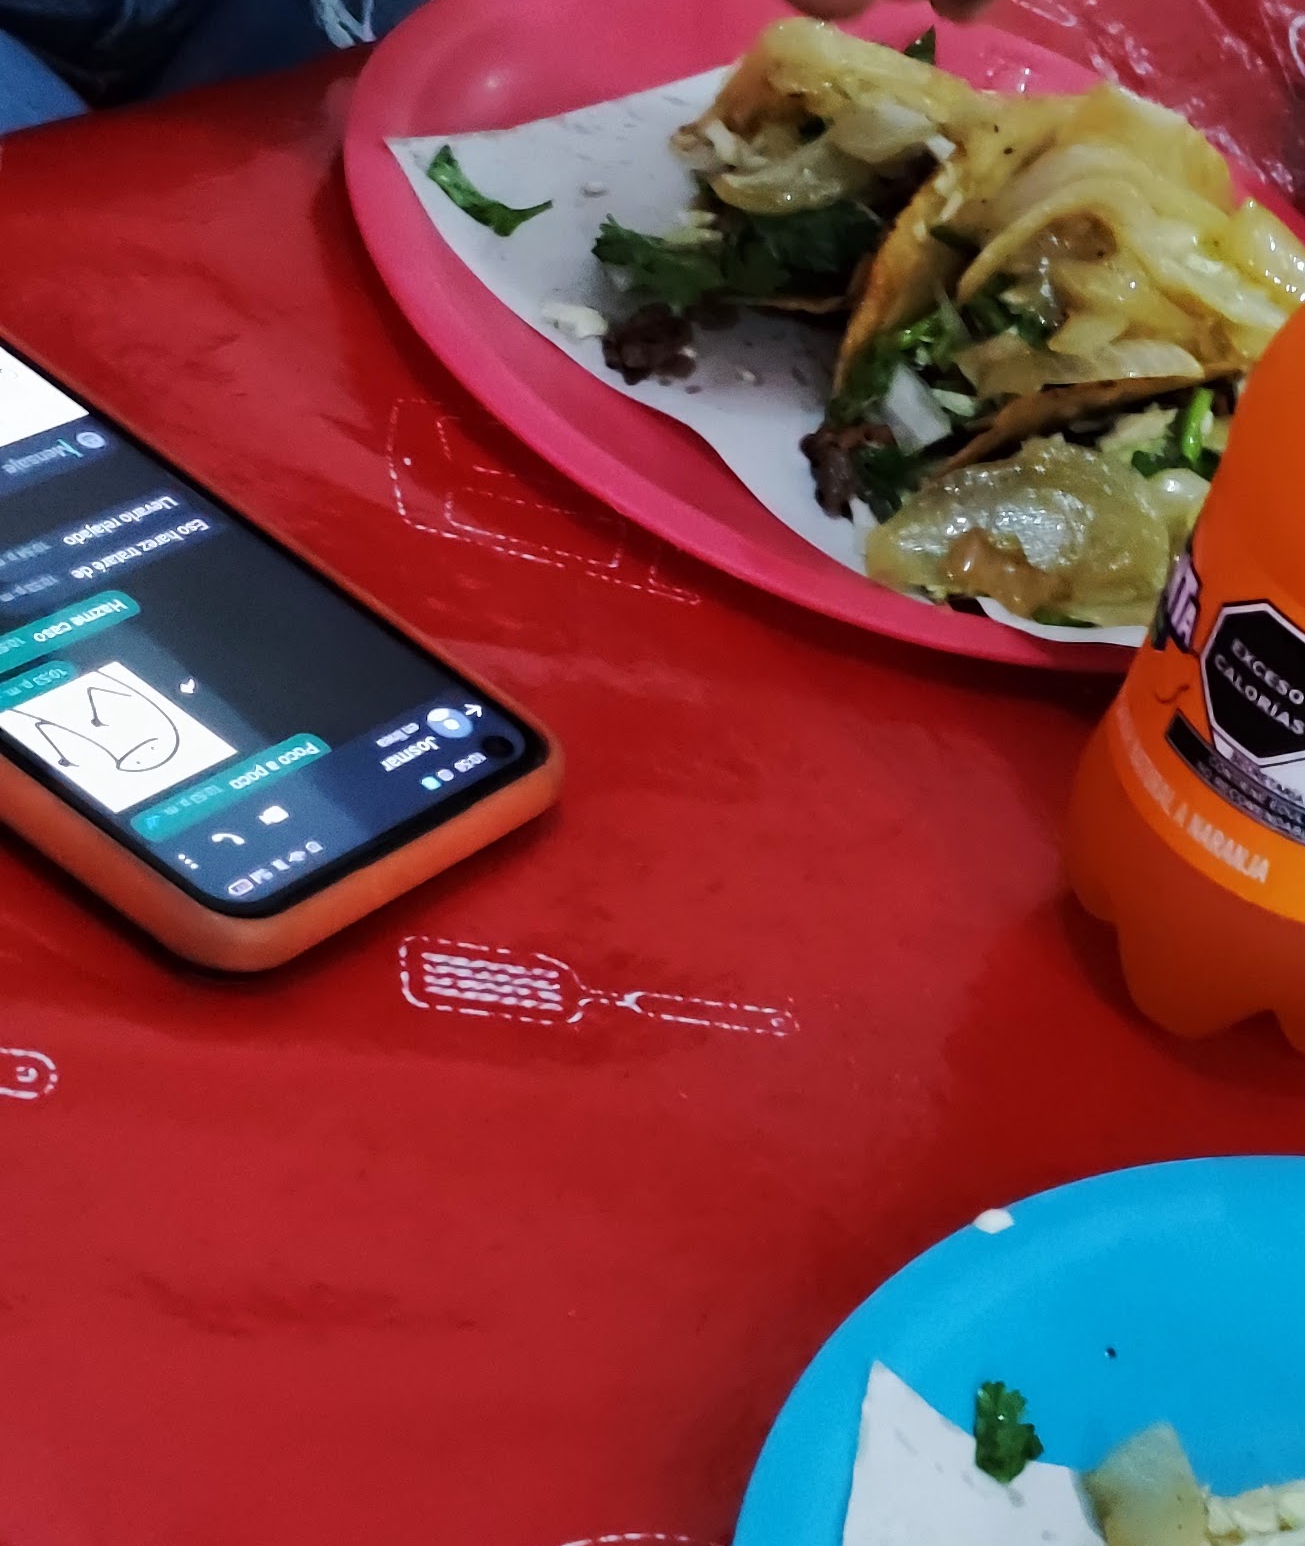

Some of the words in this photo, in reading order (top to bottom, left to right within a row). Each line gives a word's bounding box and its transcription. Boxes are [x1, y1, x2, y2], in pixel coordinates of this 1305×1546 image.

[62, 519, 122, 546] relajado
[177, 518, 210, 532] Eso
[70, 565, 94, 579] de
[70, 598, 128, 627] Hazme
[33, 621, 73, 642] caso
[1231, 637, 1305, 705] EXCESO
[1214, 653, 1305, 736] CALORÍAS
[265, 760, 280, 771] a
[278, 741, 321, 765] Poco
[381, 736, 440, 772] Josmar
[229, 764, 269, 790] poco
[1186, 812, 1270, 884] NARANJA
